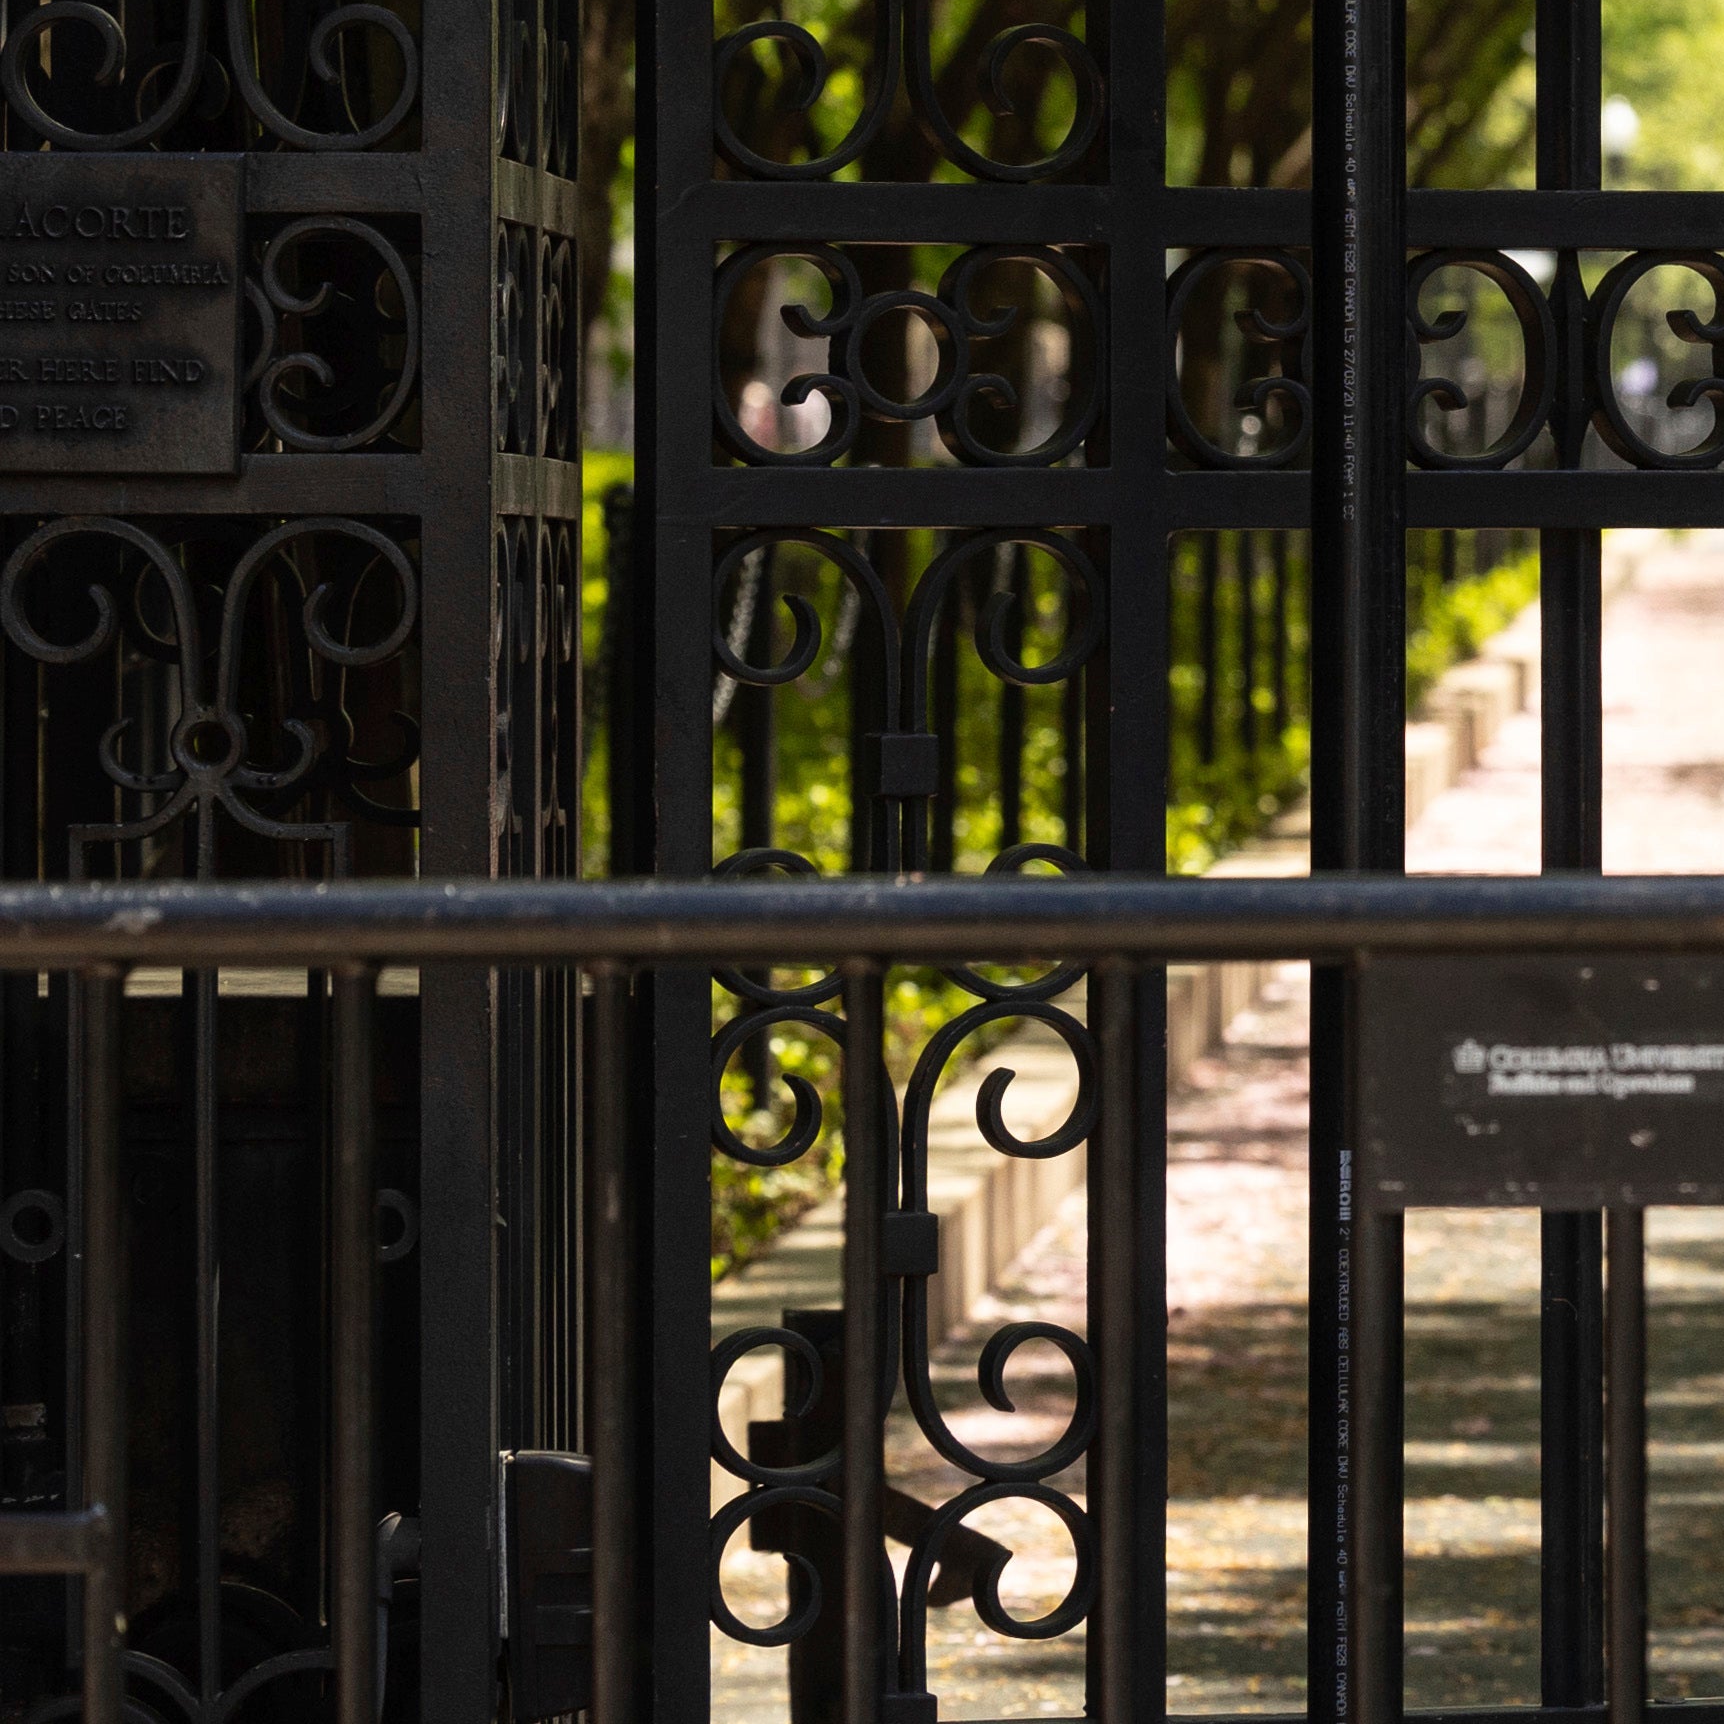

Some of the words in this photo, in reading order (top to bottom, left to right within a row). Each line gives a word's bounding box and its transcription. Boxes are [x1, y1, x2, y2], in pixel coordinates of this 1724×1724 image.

[1344, 65, 1357, 87] DWV
[1344, 94, 1357, 151] Schedule
[8, 262, 56, 284] SON
[66, 264, 97, 284] OF
[104, 261, 228, 284] COLUMBIA
[67, 300, 143, 322] GATES
[1344, 278, 1356, 322] CANADA
[39, 358, 119, 383] HERE
[132, 358, 206, 384] FIND
[1343, 349, 1356, 407] 27/03/20
[35, 404, 130, 430] PEACE
[1343, 414, 1355, 450] 11:40
[1338, 1248, 1350, 1321] COEXTRUDED
[1338, 1356, 1349, 1414] CELLULAR
[1336, 1484, 1349, 1543] Schedule
[1336, 1672, 1348, 1717] CANADA
